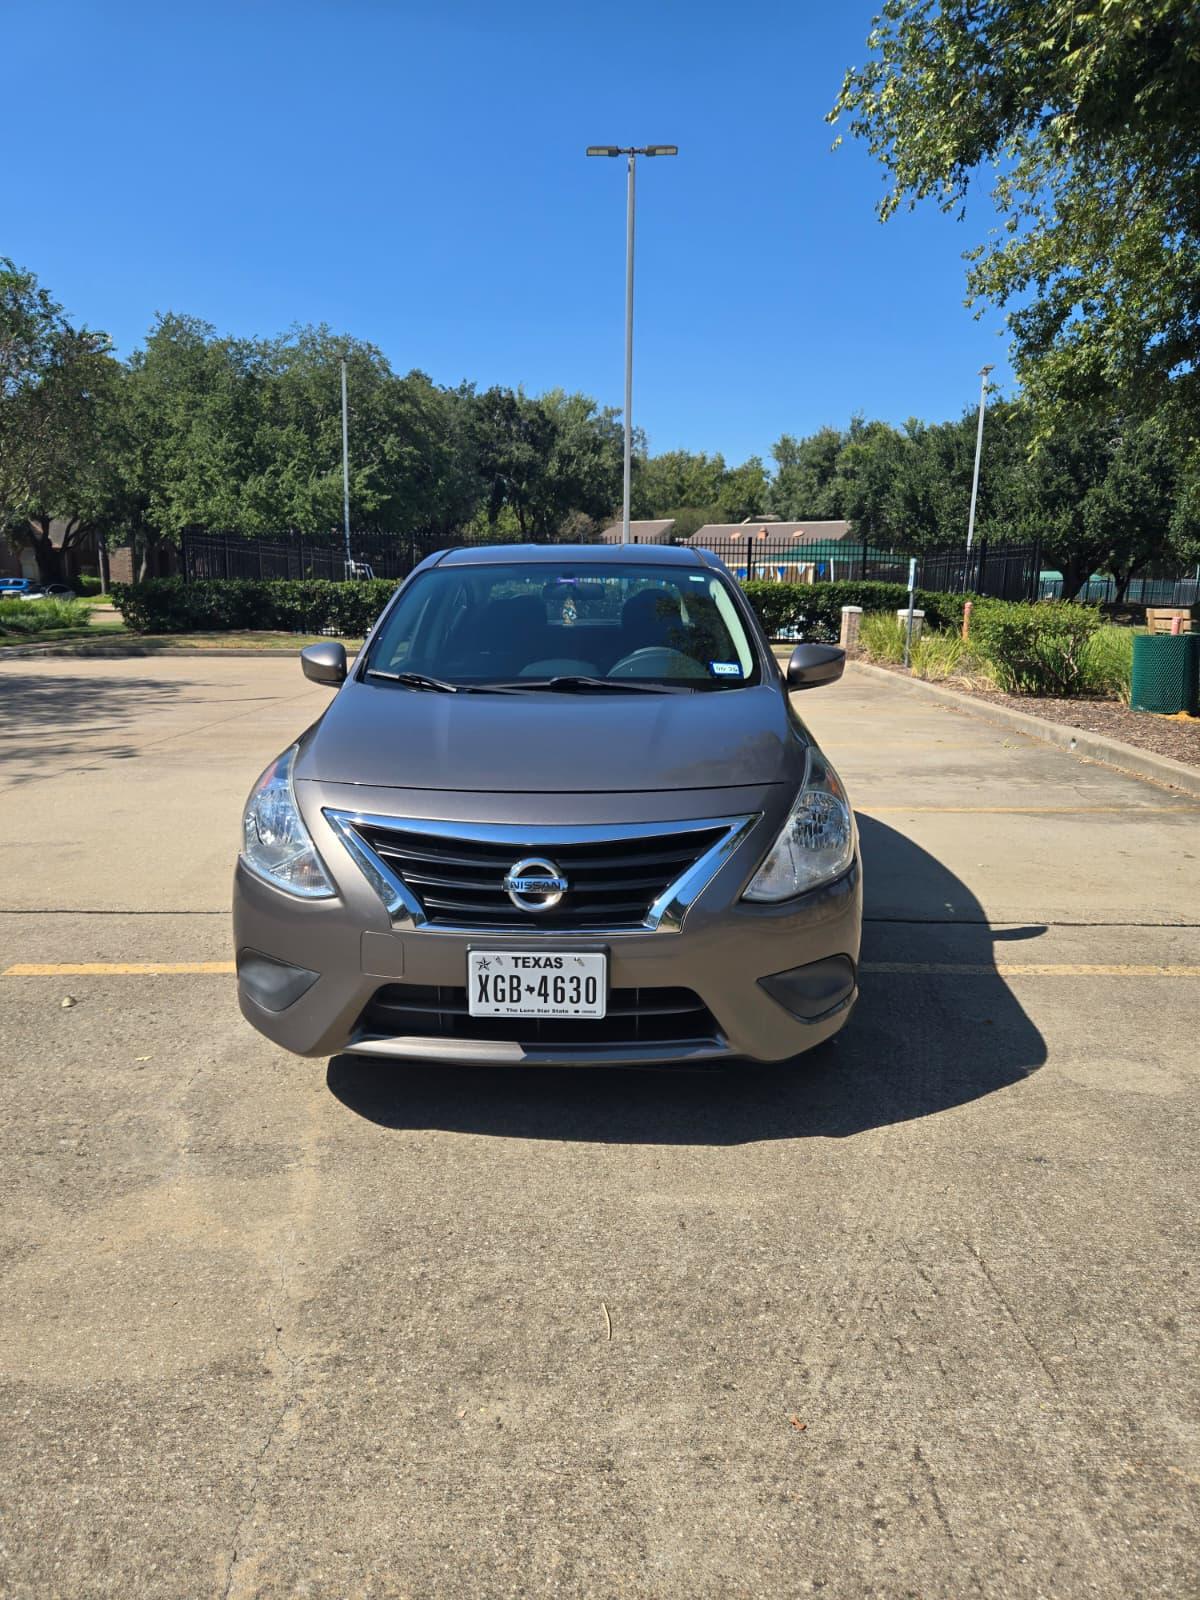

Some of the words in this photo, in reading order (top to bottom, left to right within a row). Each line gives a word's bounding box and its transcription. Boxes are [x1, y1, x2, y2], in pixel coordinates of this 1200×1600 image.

[510, 881, 560, 890] NISSAN
[512, 956, 563, 969] TEXAS
[477, 974, 522, 1003] XGB
[537, 975, 597, 1004] 4630
